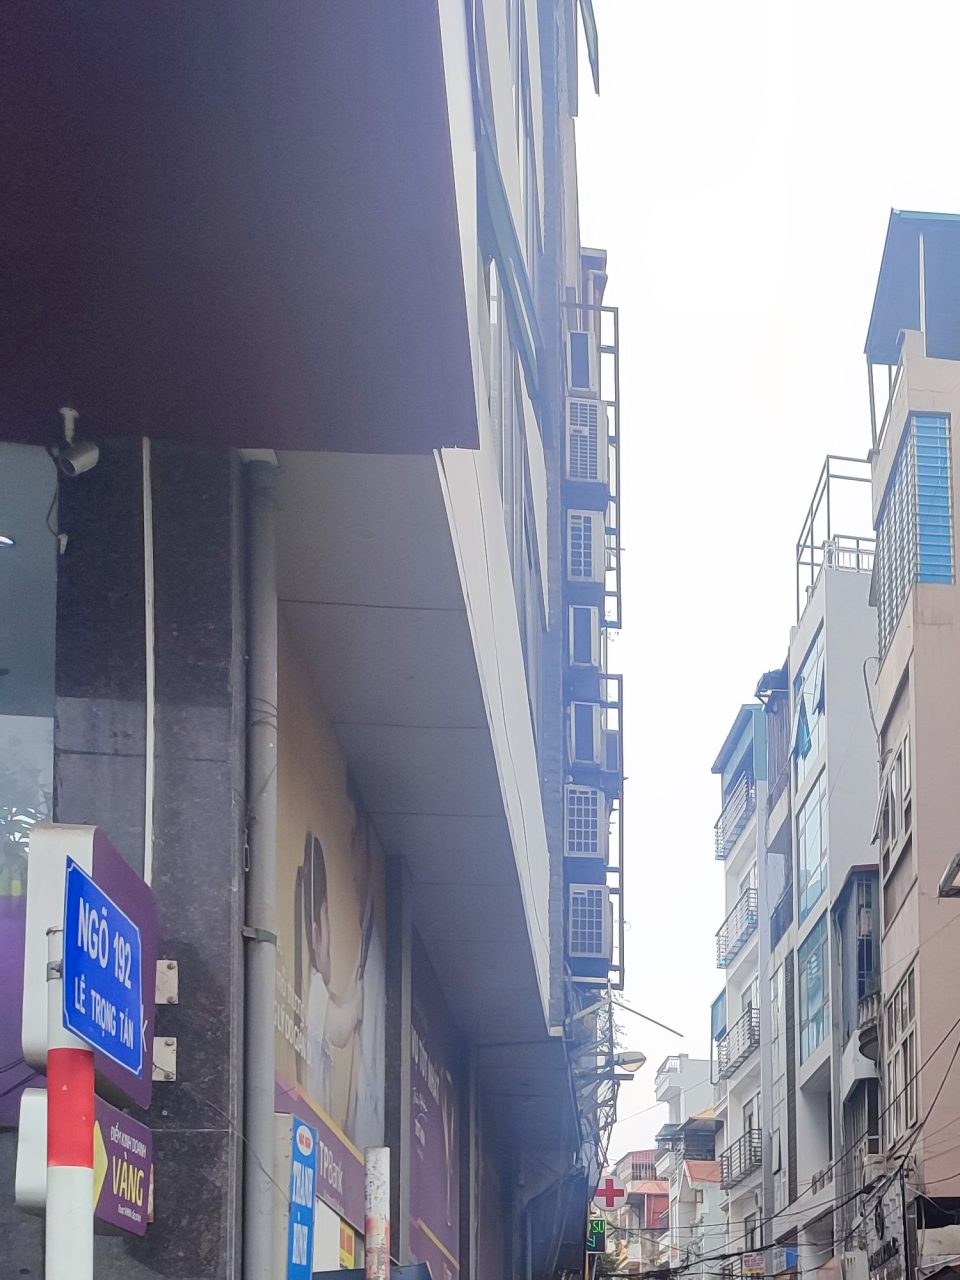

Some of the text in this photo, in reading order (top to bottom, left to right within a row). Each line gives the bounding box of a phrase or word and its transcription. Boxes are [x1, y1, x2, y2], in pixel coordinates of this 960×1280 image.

[77, 897, 132, 990] NGÕ 192
[74, 974, 86, 1015] LÊ
[90, 989, 117, 1037] TRỌNG
[119, 1007, 134, 1050] TẤN
[111, 1151, 145, 1207] VÀNG
